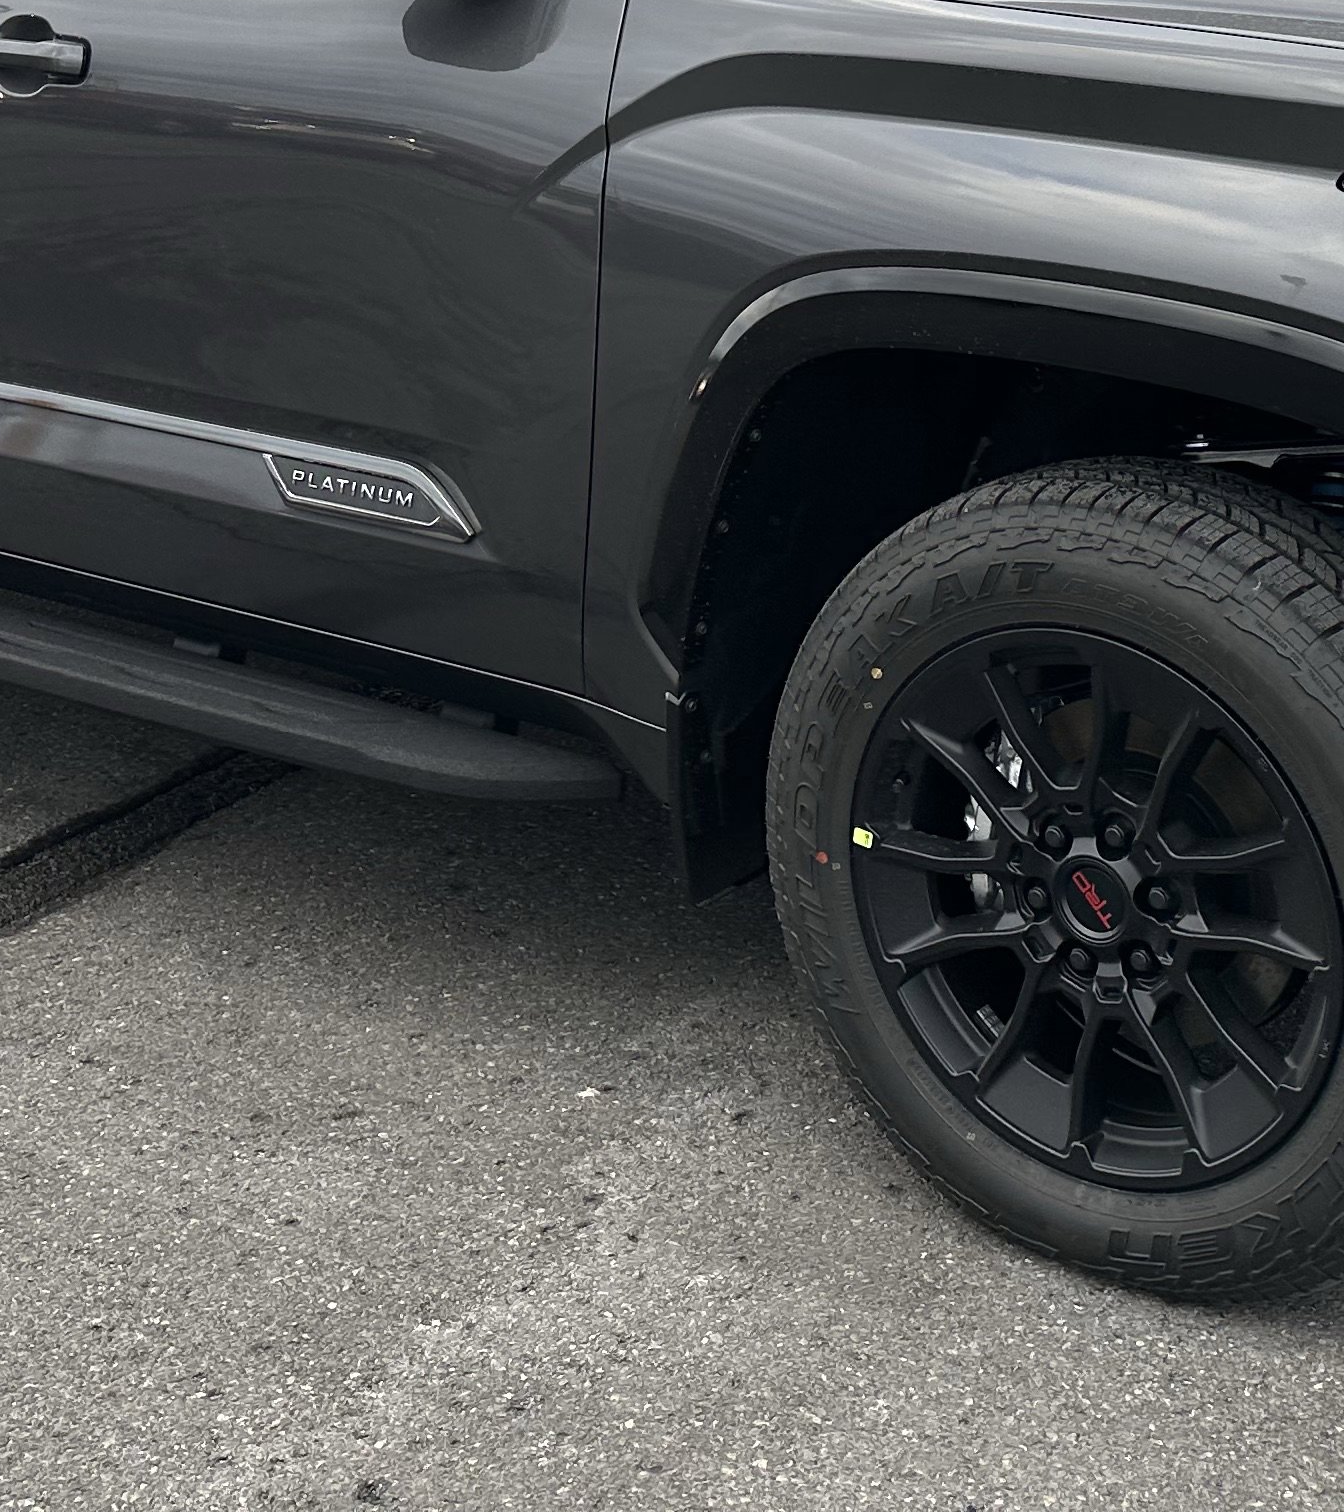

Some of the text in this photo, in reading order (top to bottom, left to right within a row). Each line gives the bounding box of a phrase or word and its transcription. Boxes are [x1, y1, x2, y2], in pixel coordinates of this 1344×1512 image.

[291, 469, 414, 508] PLATINUM
[929, 559, 1055, 617] A/T
[1072, 871, 1112, 929] TRD
